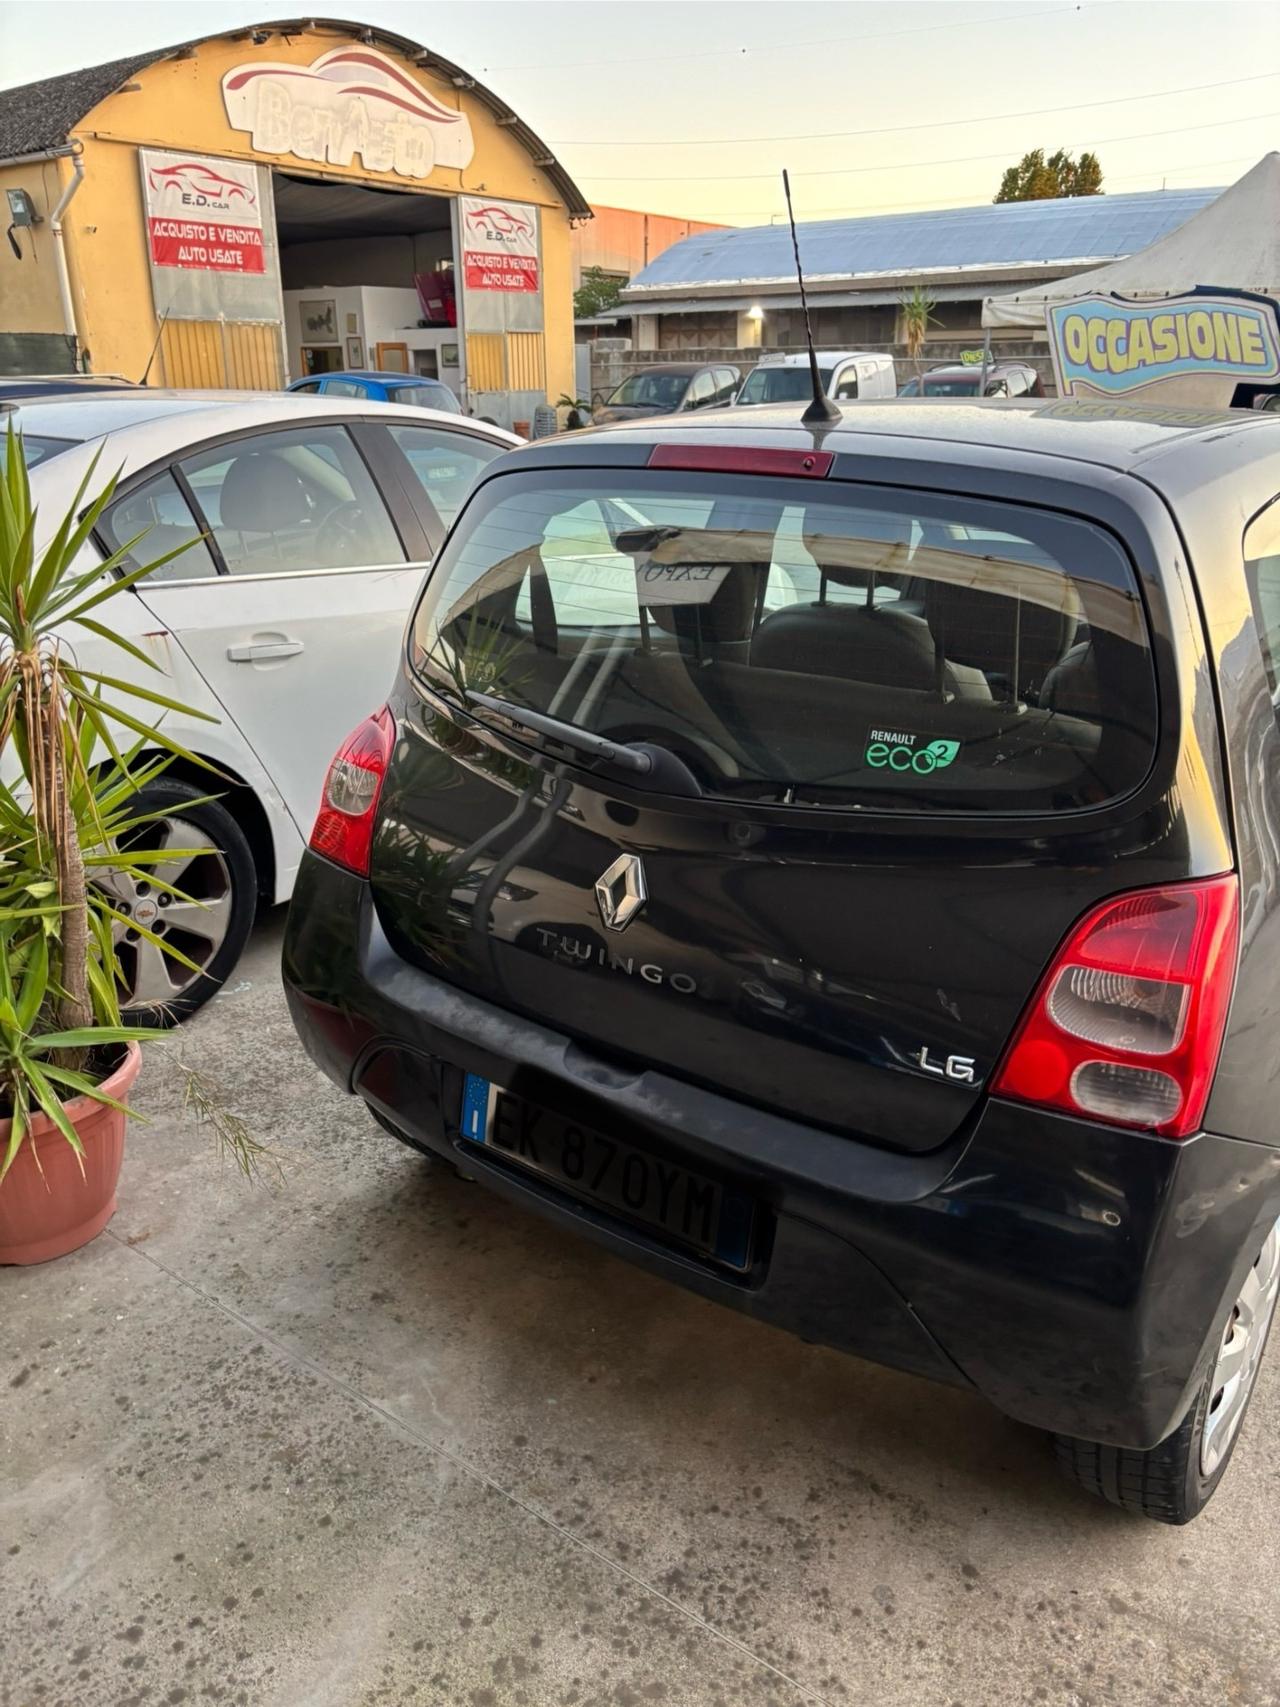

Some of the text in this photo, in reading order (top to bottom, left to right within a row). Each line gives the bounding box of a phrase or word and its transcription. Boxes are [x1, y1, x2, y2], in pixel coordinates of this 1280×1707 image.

[181, 192, 210, 208] E.D.
[153, 221, 262, 246] ACQUISTO E VENDITA
[486, 230, 505, 242] E.D.
[178, 245, 243, 265] AUTO USATE
[467, 254, 502, 268] ACQUISTO
[503, 257, 509, 269] E
[482, 272, 524, 287] AUTO USATE
[1064, 310, 1267, 375] OCCASIONE
[870, 729, 917, 745] RENAULT
[536, 927, 697, 994] TWINGO
[920, 1046, 976, 1083] LG
[493, 1090, 543, 1163] EK
